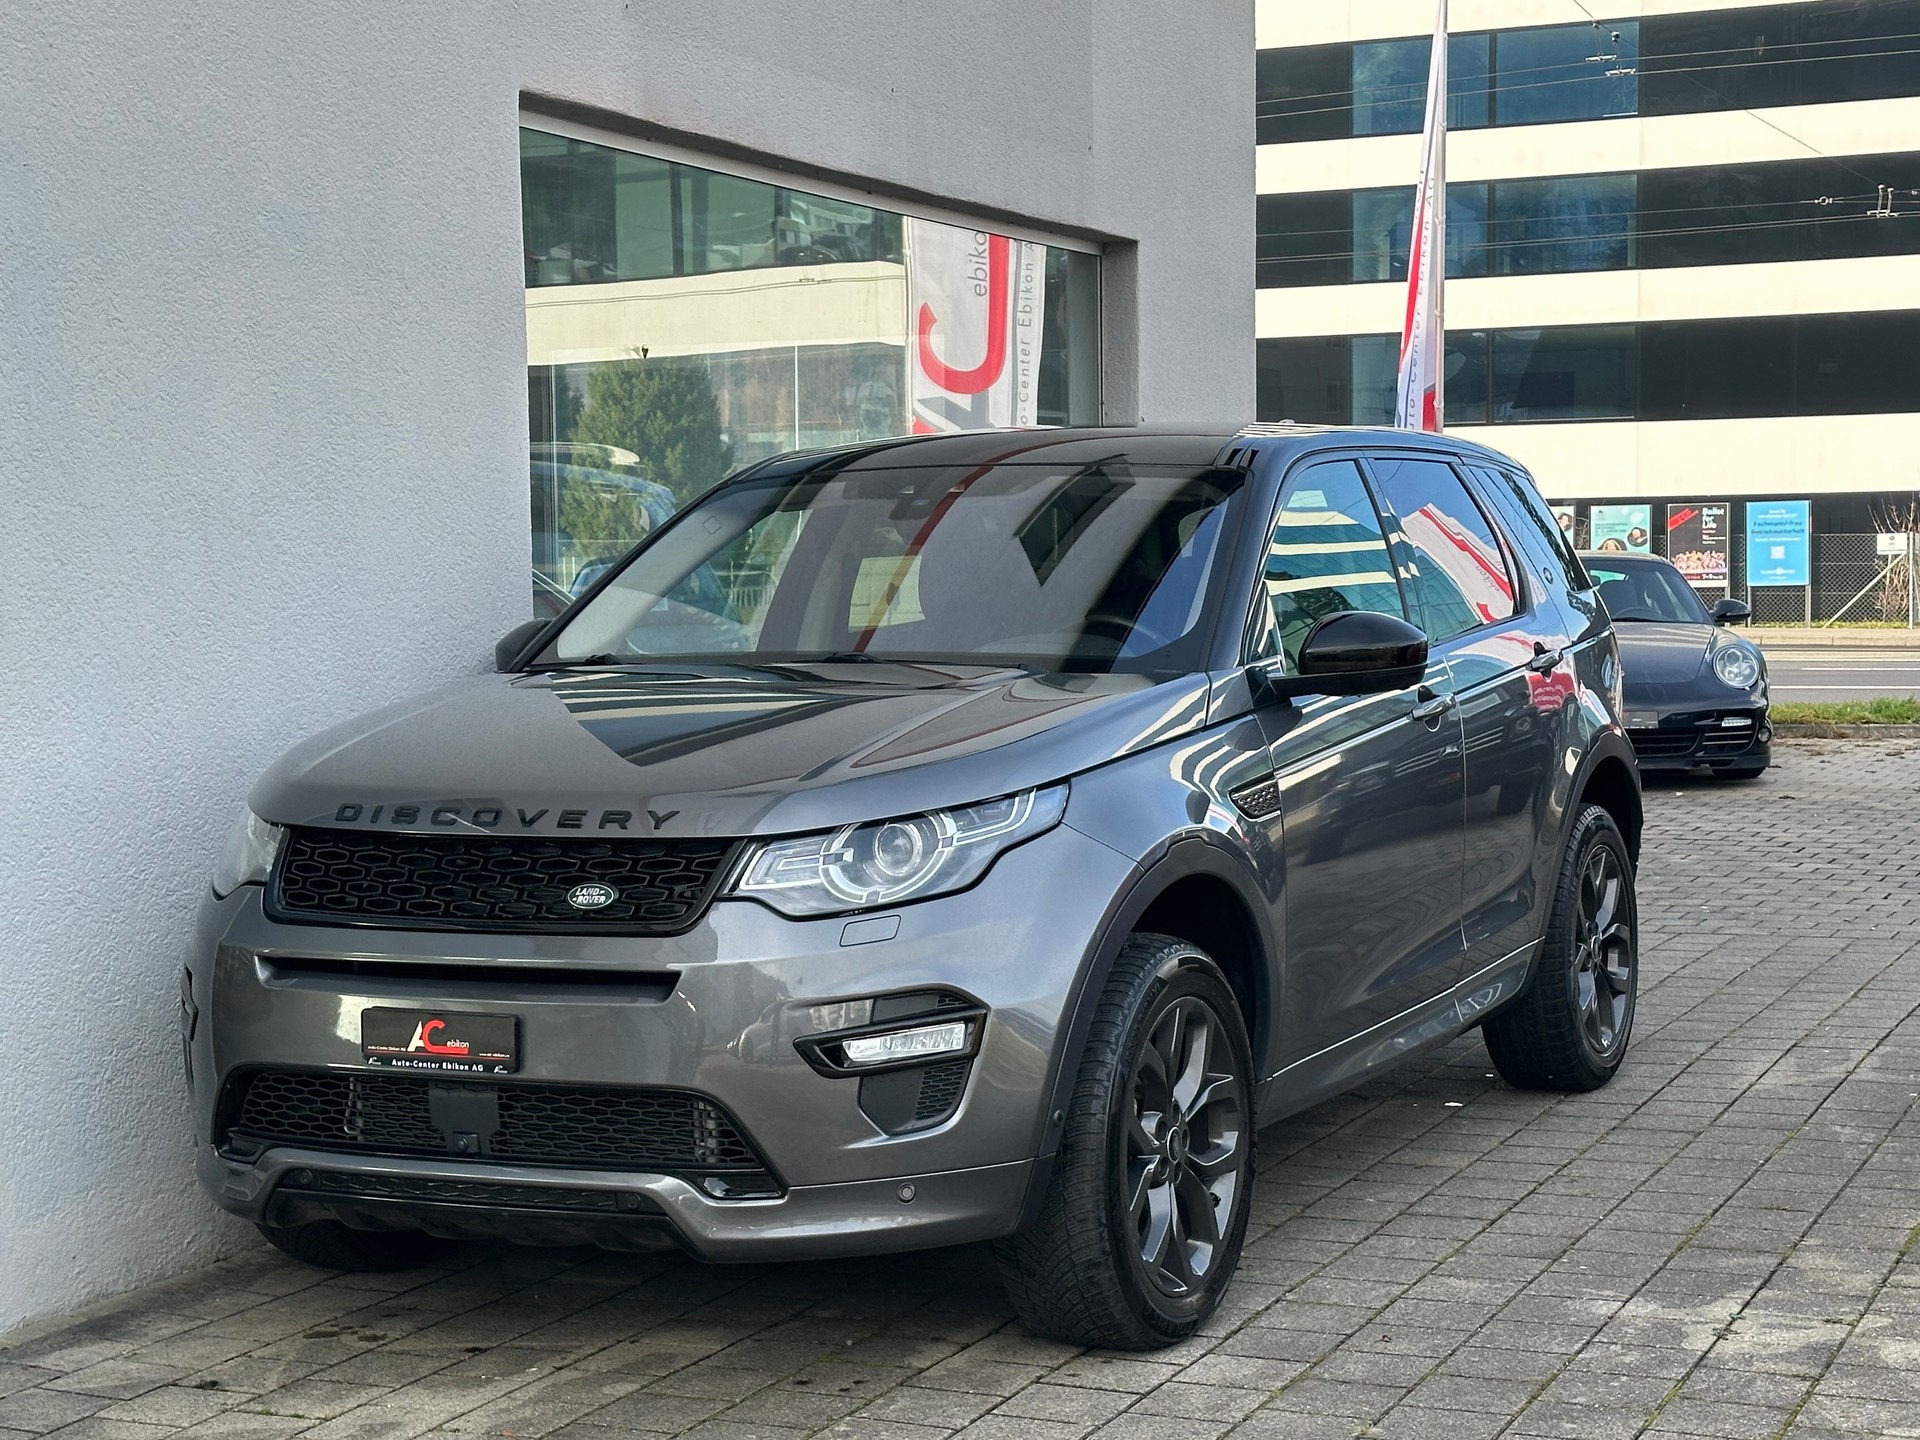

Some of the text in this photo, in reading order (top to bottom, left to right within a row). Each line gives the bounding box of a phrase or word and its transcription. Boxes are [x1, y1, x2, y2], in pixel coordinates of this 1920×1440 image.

[1017, 261, 1034, 327] Ebikon
[334, 802, 681, 830] DISCOVERY
[446, 1039, 470, 1048] ebikon
[391, 1058, 484, 1072] Auto-Center Ebikon AG
